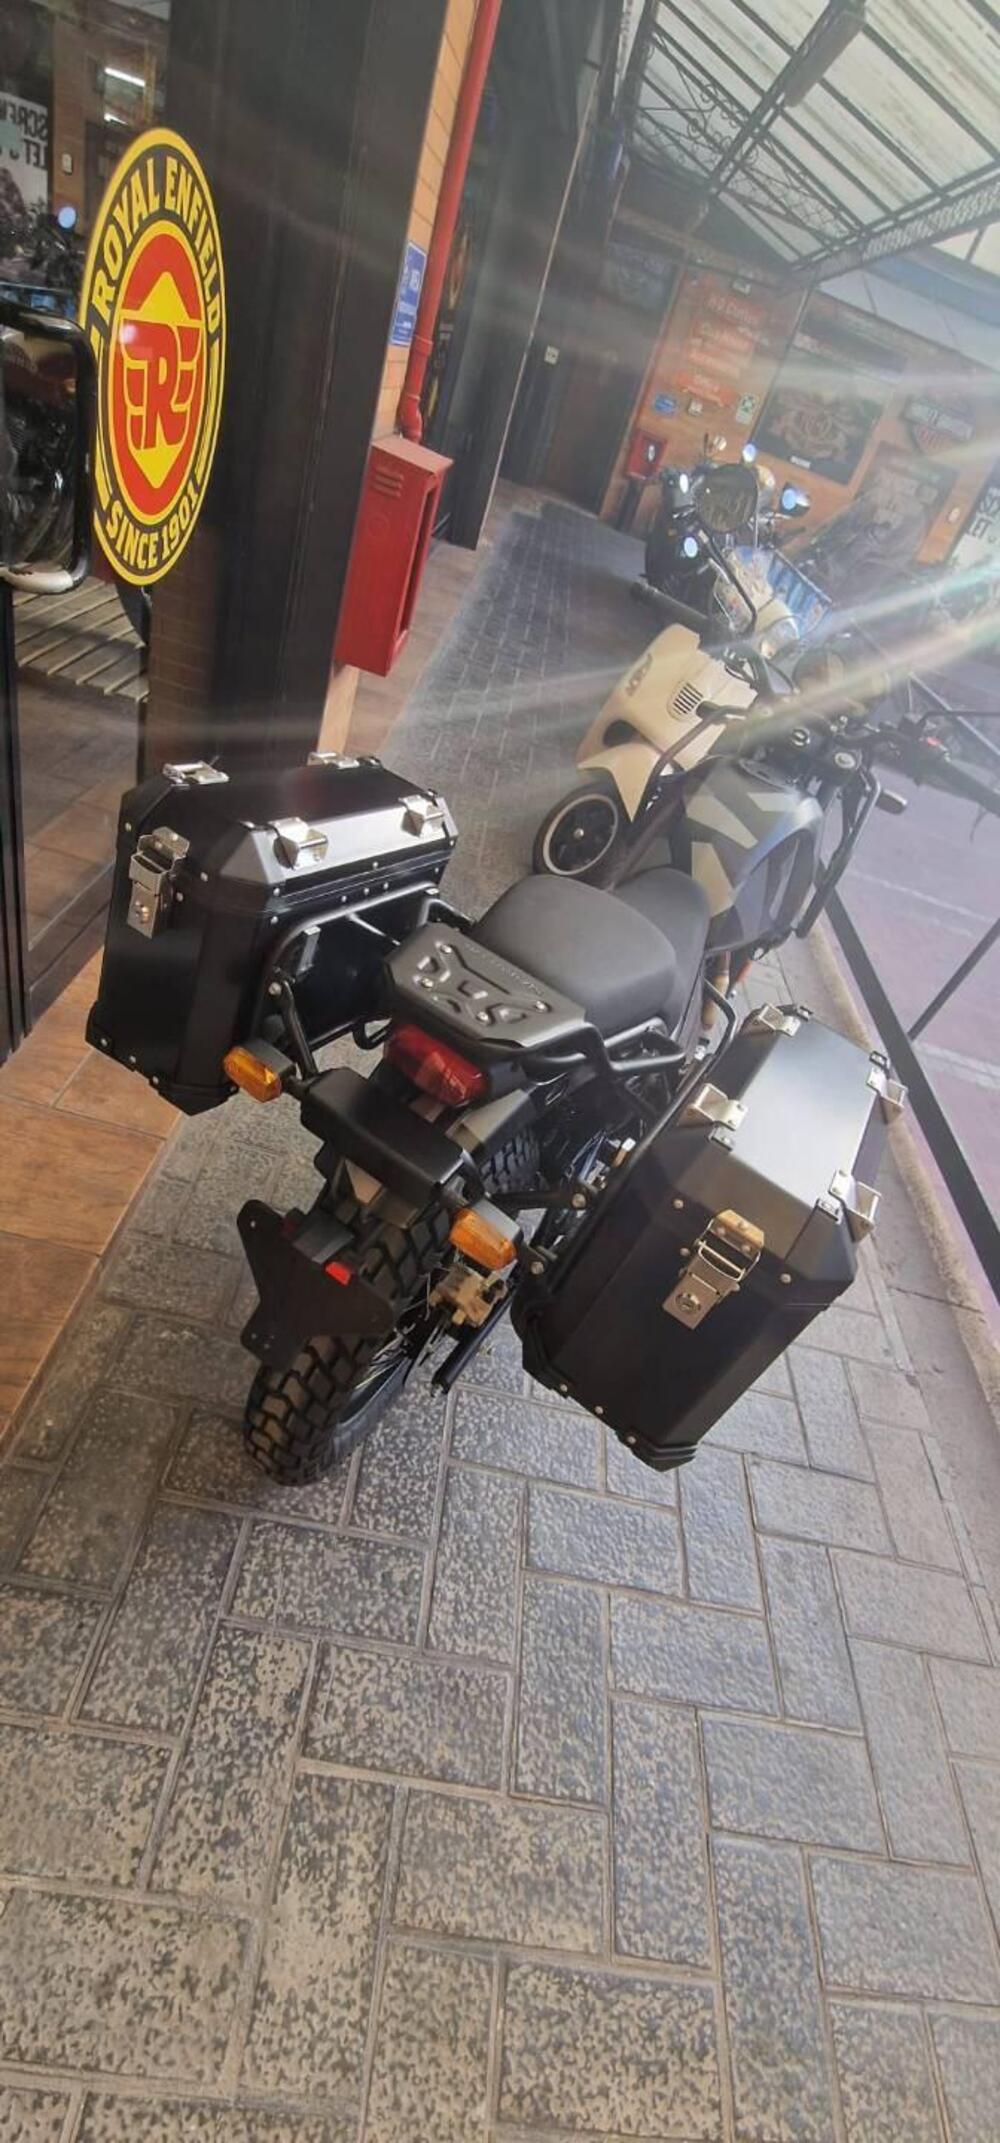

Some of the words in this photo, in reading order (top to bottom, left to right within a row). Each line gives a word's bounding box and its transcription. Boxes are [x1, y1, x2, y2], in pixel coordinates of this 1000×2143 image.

[92, 158, 160, 326] ROYAL
[164, 156, 221, 334] ENFIELD
[106, 500, 159, 569] SINCE
[161, 478, 200, 560] 1901
